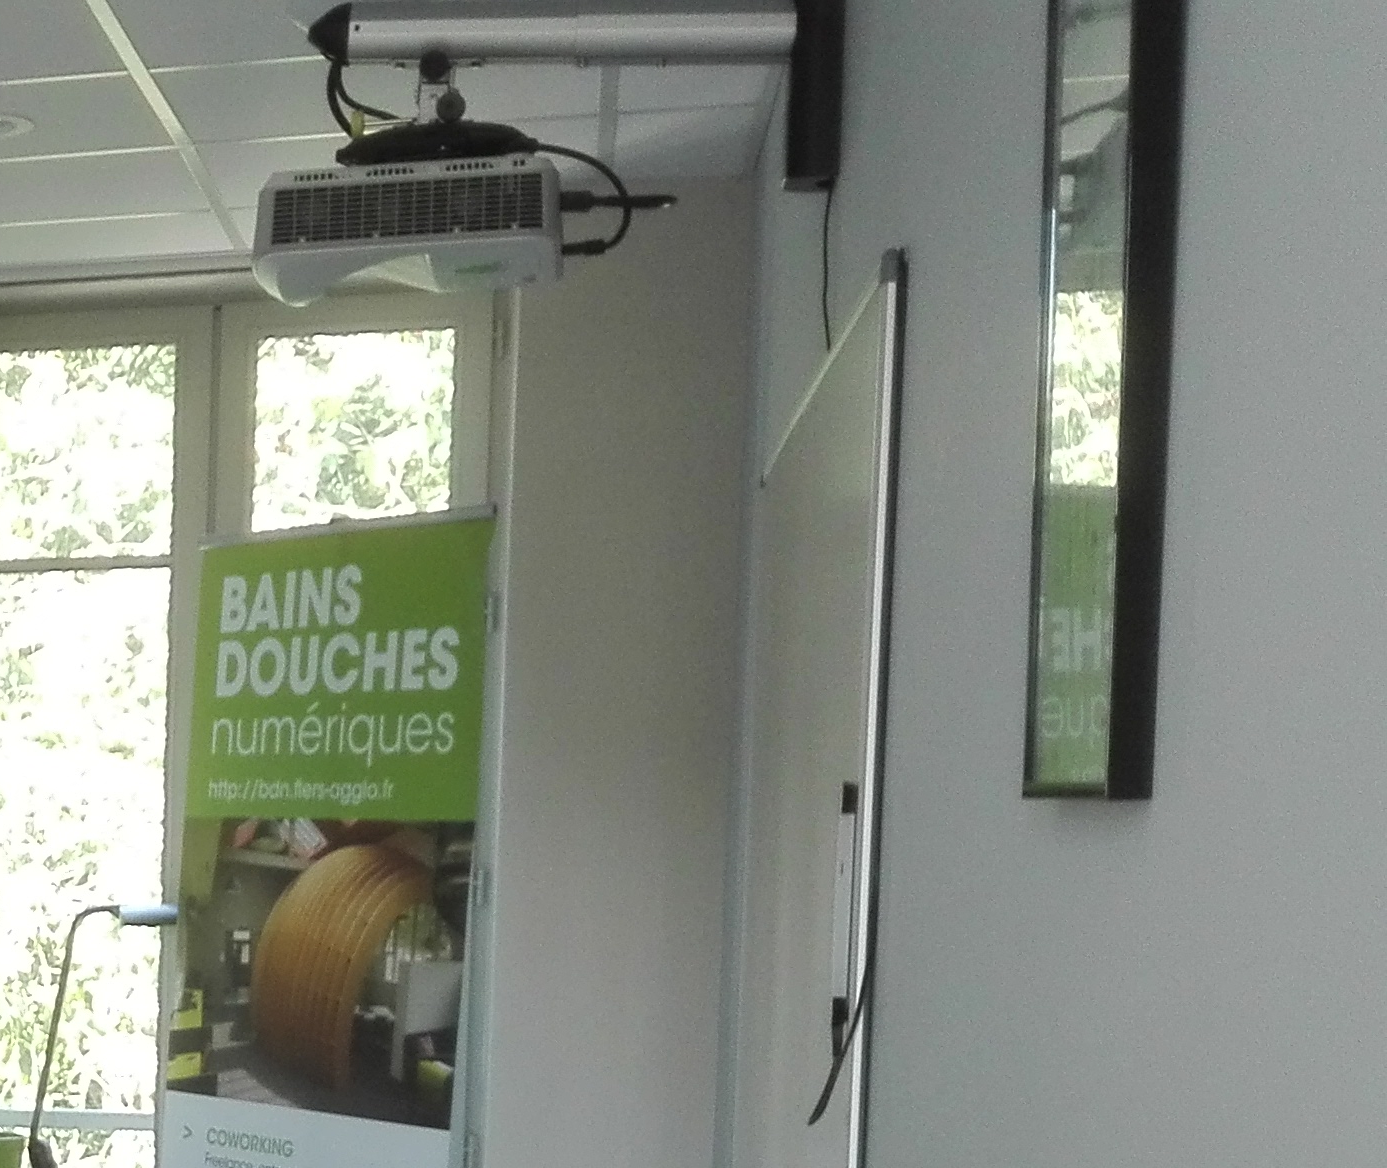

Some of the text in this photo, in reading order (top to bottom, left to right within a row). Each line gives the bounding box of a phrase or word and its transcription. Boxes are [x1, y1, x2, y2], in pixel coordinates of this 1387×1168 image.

[219, 563, 363, 633] BAINS
[214, 626, 461, 698] DOUCHES
[210, 701, 455, 767] numériques
[206, 1127, 295, 1158] COWORKING
